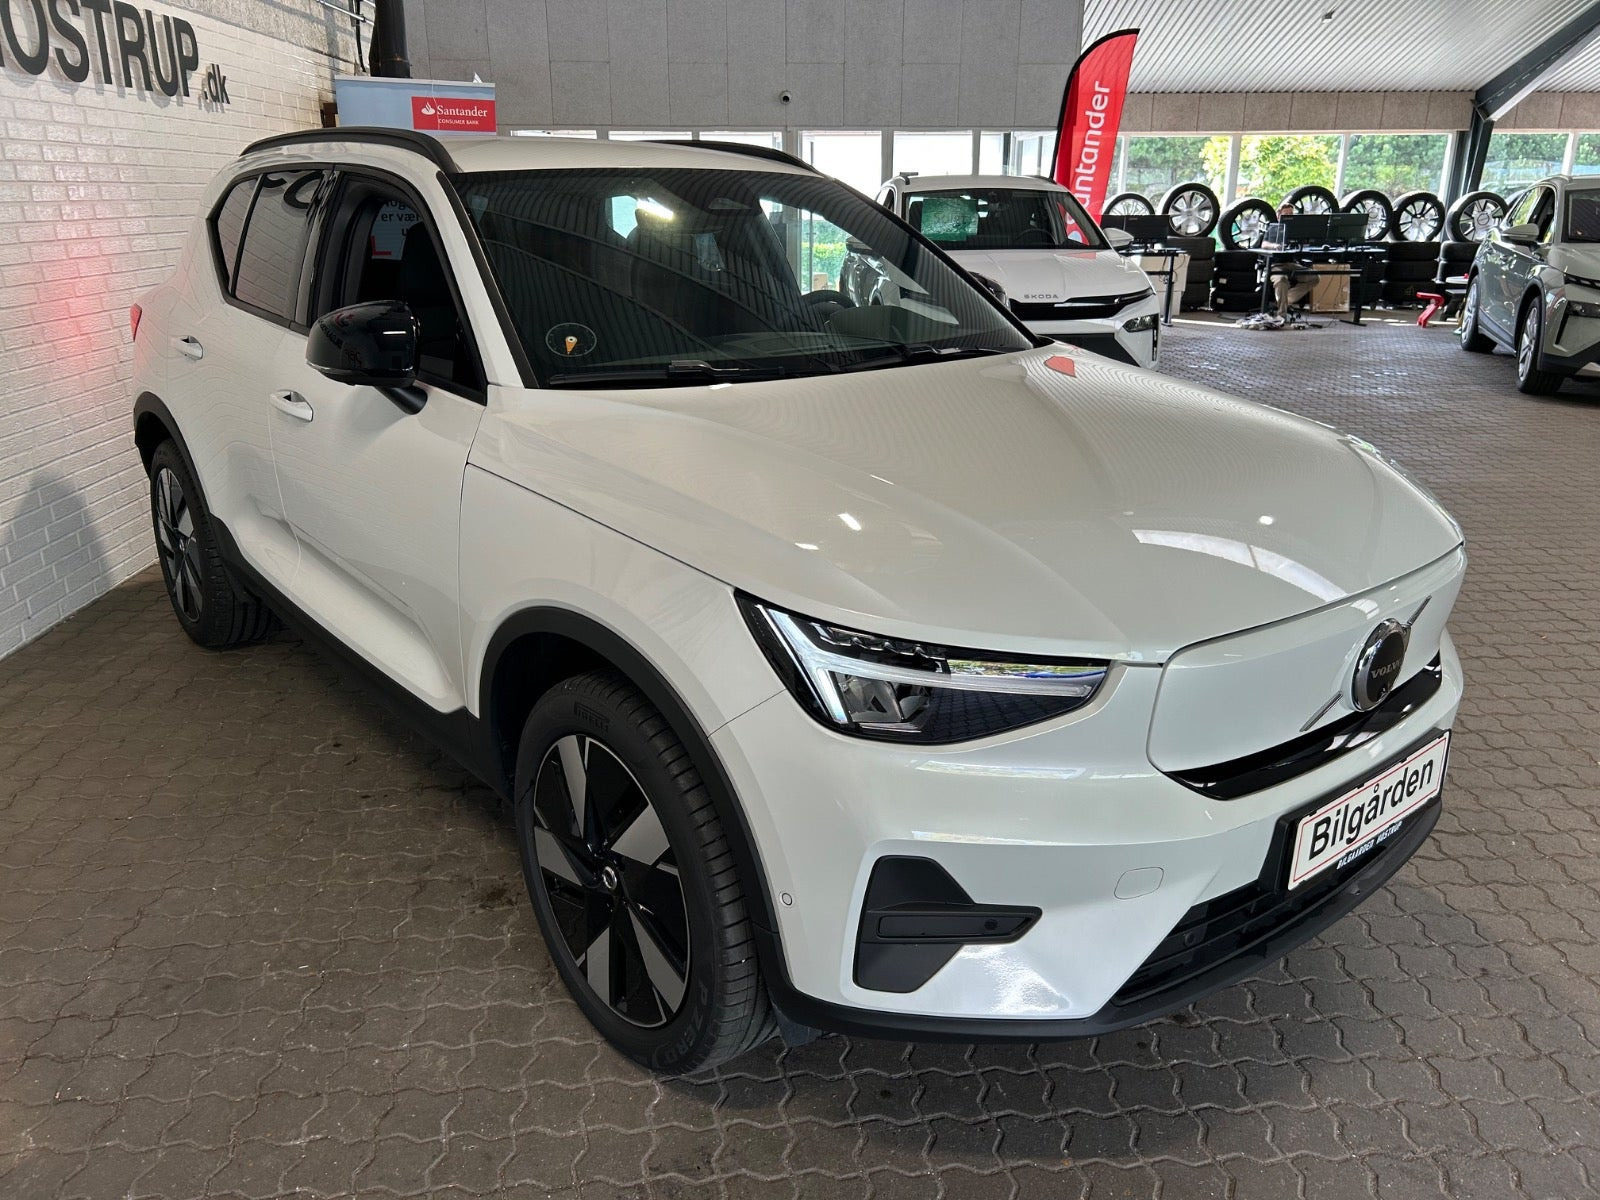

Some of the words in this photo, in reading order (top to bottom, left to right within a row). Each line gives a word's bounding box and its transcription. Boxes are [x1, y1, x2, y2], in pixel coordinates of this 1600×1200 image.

[0, 0, 199, 97] OSTRUP
[437, 104, 488, 117] Santander
[1308, 758, 1434, 861] Bilgården
